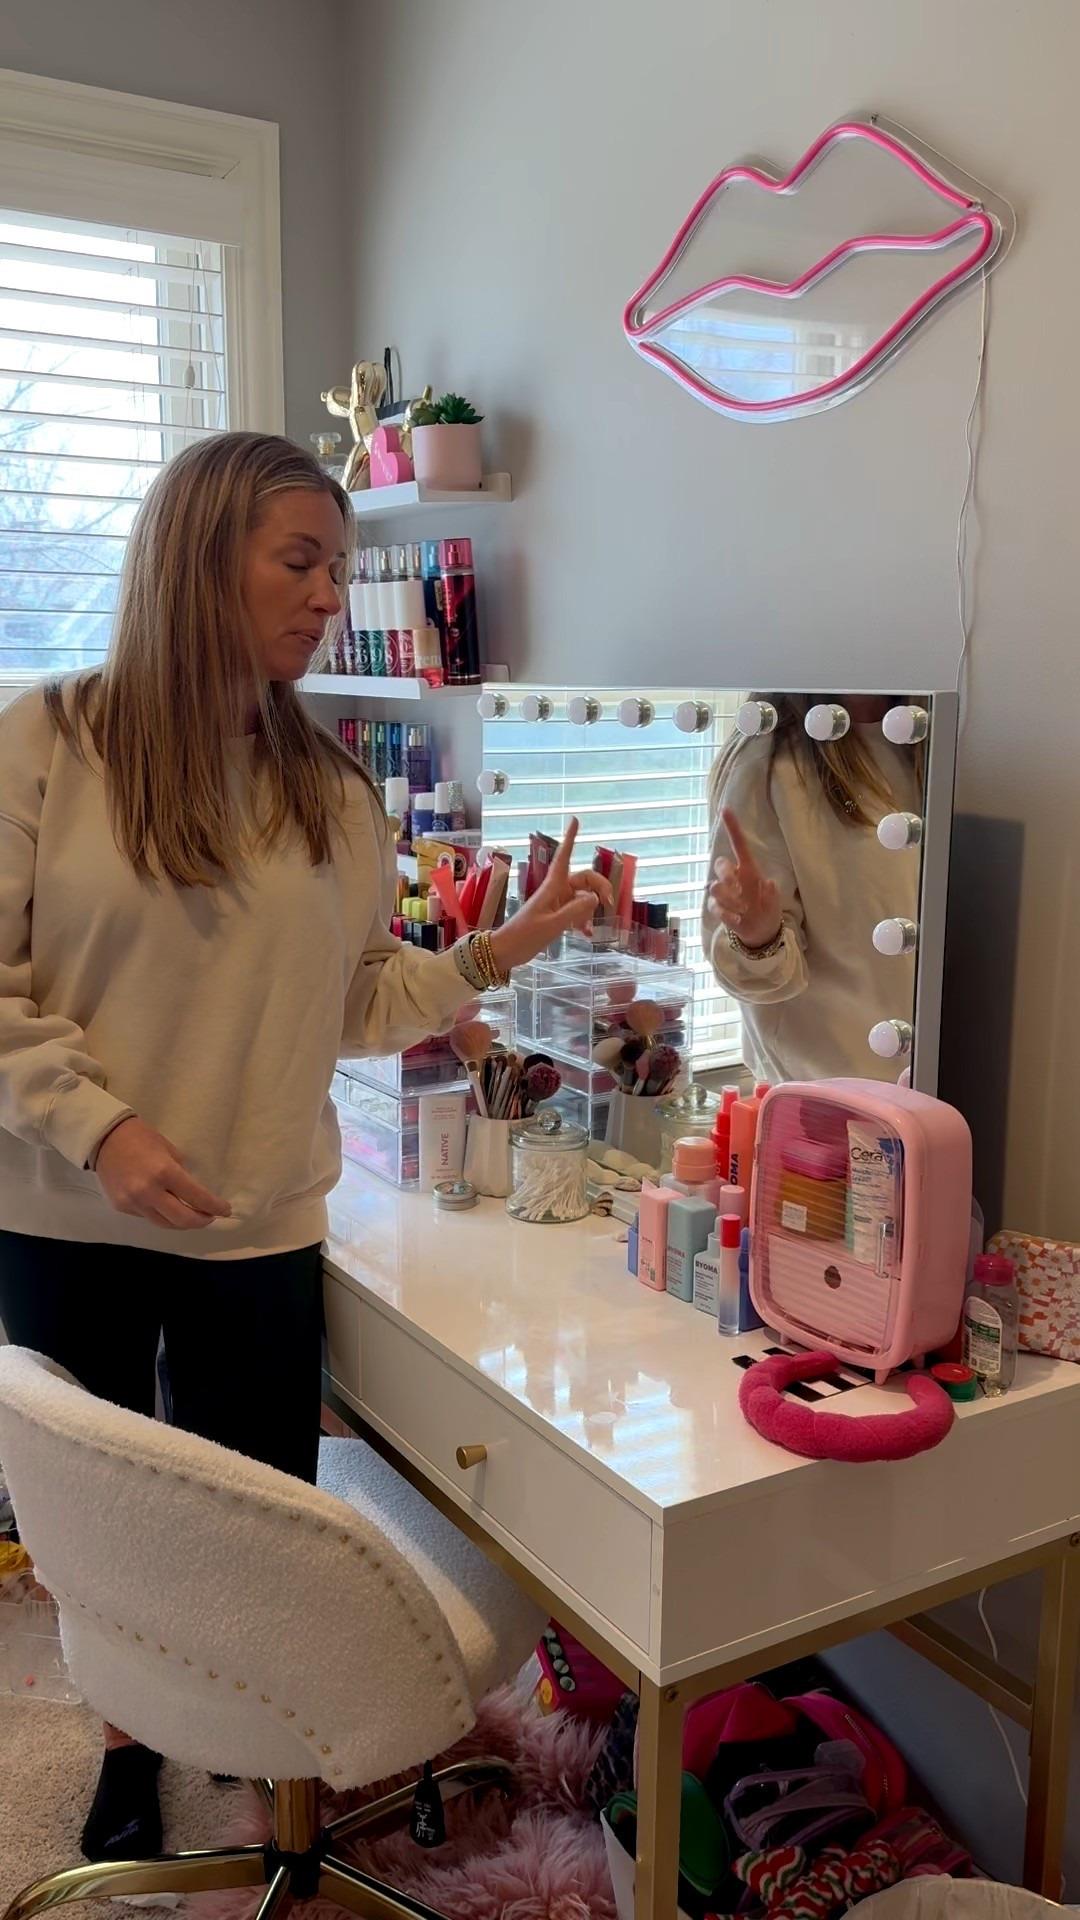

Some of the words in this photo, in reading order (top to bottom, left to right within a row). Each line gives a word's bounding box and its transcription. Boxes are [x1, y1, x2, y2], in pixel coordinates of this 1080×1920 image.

[440, 1133, 449, 1166] NATIVE
[850, 1147, 883, 1162] Cera
[730, 1153, 739, 1185] OMA
[695, 1260, 718, 1275] BYOMA
